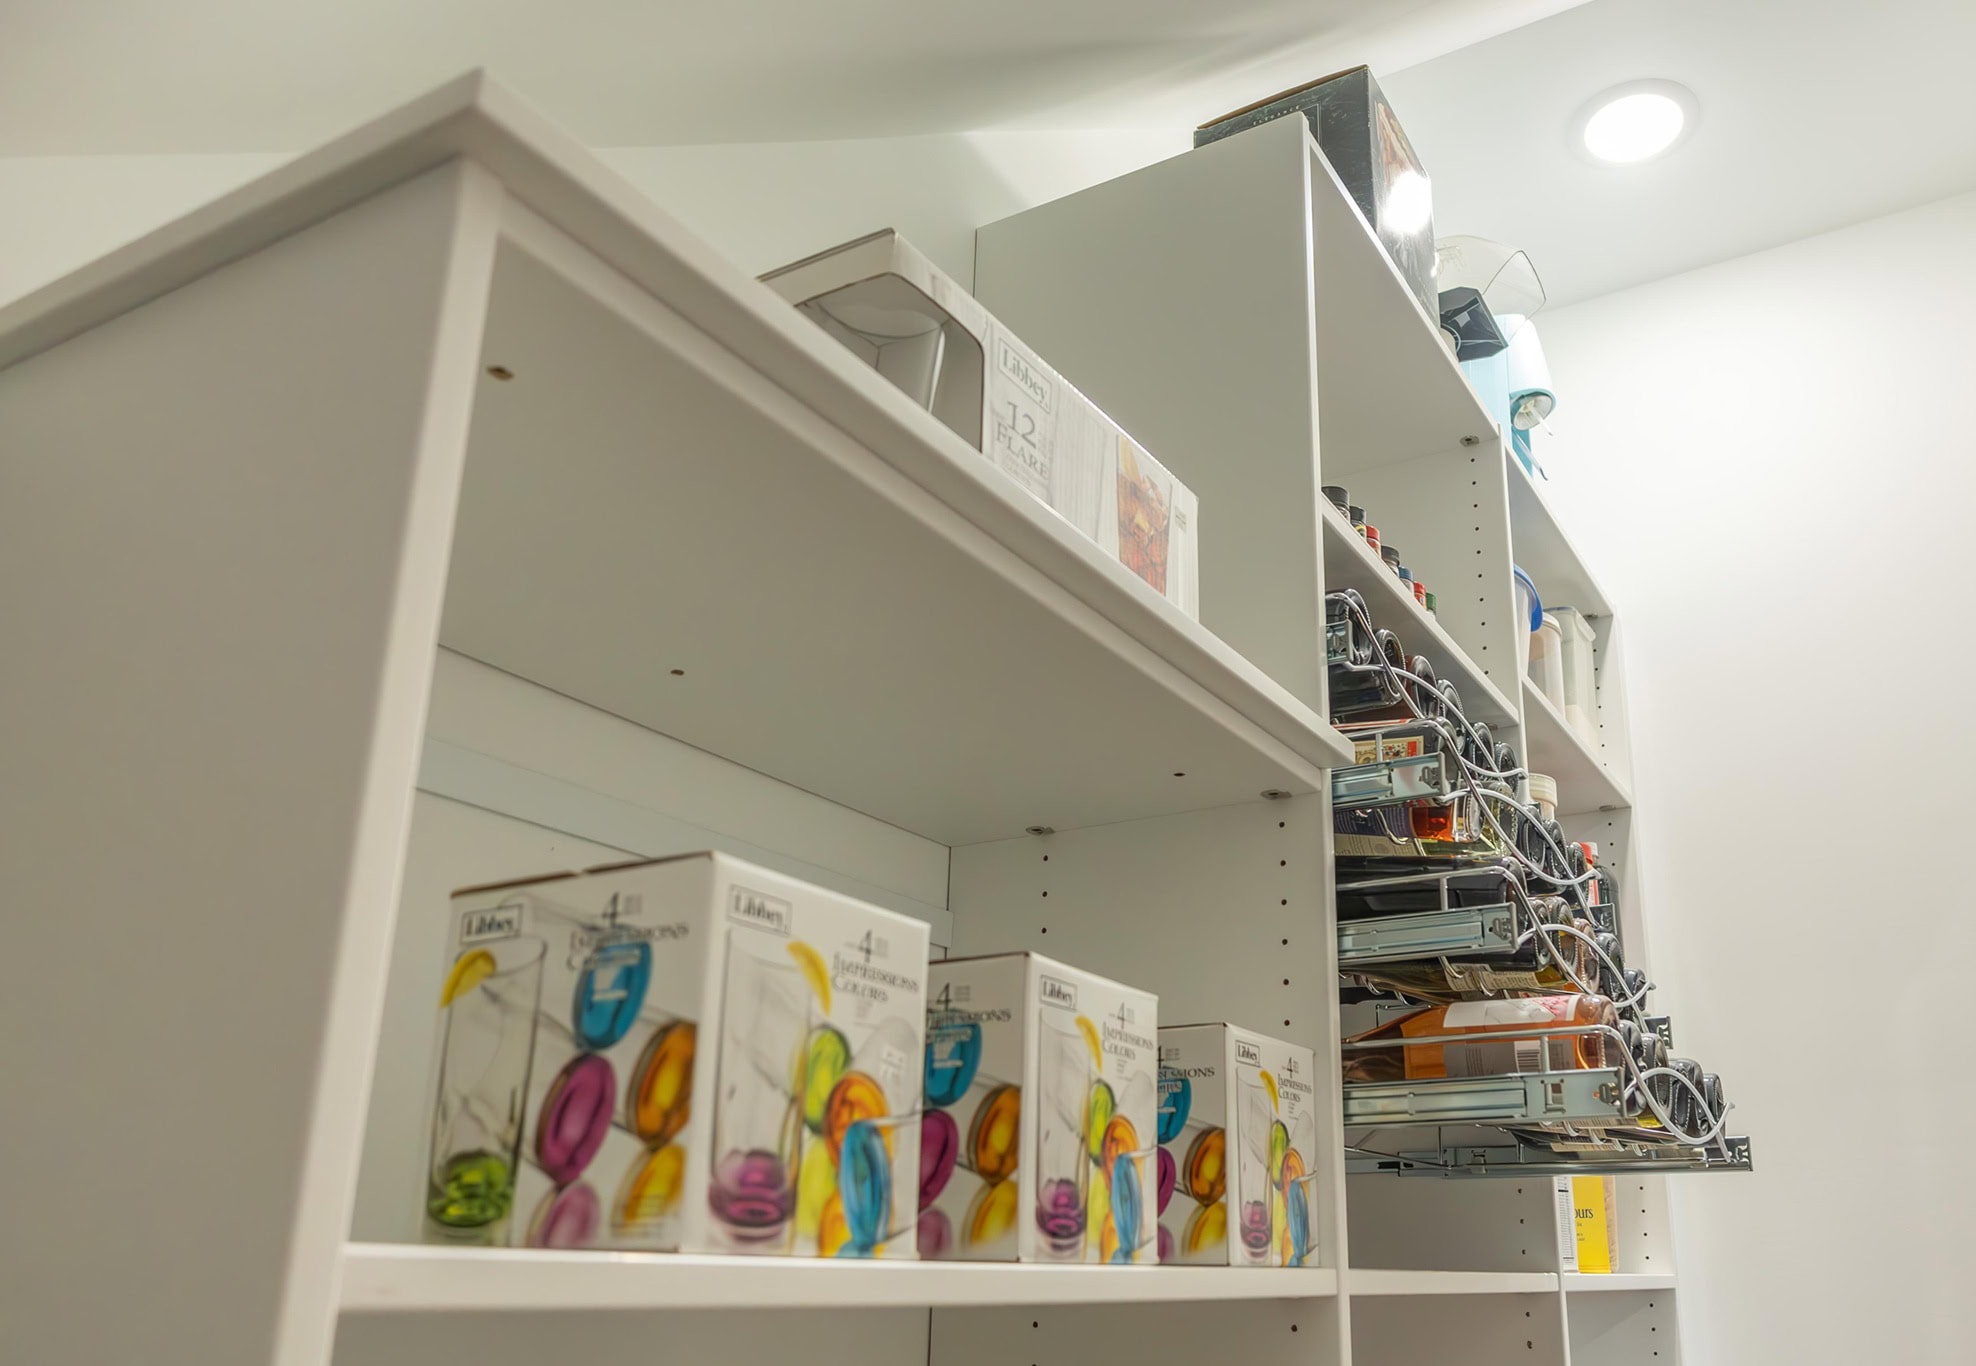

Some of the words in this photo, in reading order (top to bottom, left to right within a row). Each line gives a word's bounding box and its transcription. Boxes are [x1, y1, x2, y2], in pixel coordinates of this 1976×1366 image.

[1002, 348, 1047, 402] Libbey
[1007, 401, 1036, 449] 12
[996, 421, 1049, 480] FLARE
[858, 929, 873, 963] 4
[935, 981, 951, 1011] 4
[1043, 980, 1073, 1006] Libbey
[1116, 1001, 1126, 1030] 4
[1102, 1021, 1154, 1051] IMPRESSIONS
[1102, 1040, 1136, 1061] COLORS
[1237, 1044, 1258, 1062] Libbey
[1286, 1056, 1294, 1079] 4
[1278, 1073, 1313, 1095] IMPRESSIONS
[1278, 1086, 1301, 1102] COLORS
